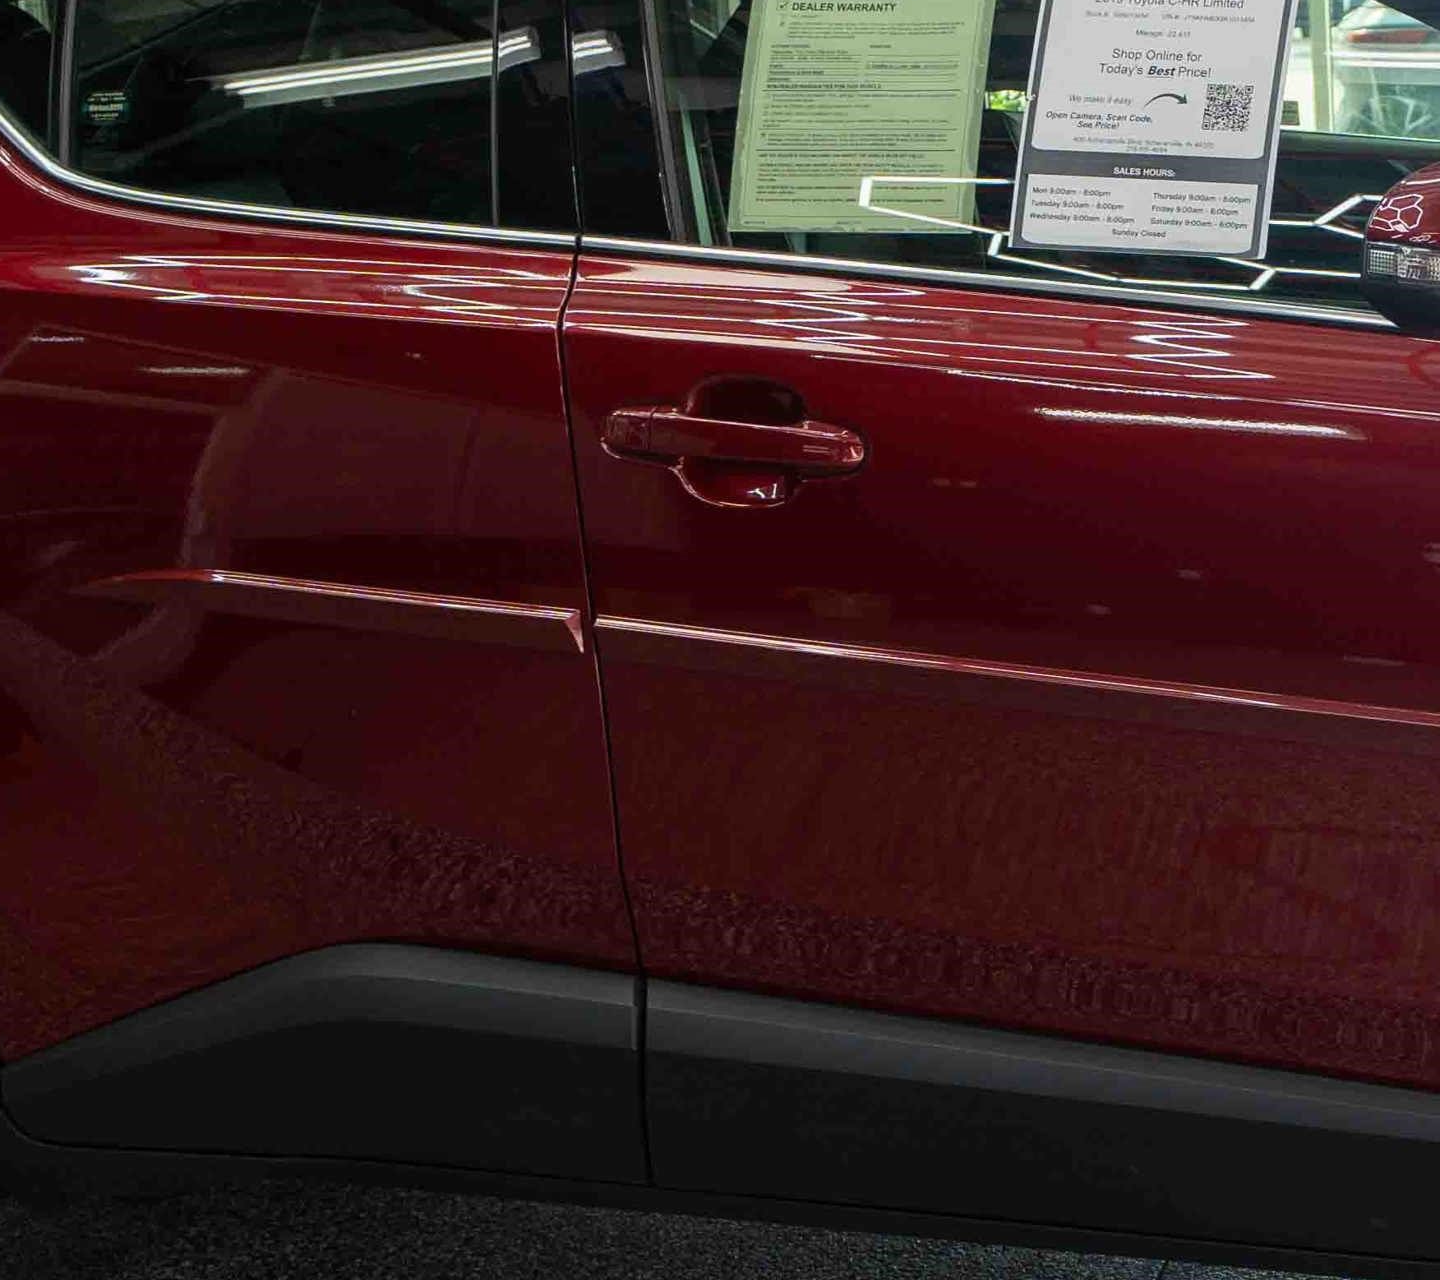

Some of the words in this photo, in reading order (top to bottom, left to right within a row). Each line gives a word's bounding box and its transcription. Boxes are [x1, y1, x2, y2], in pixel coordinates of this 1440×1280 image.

[792, 2, 834, 12] DEALER
[836, 2, 897, 13] WARRANTY
[1111, 47, 1142, 62] Shop
[1145, 49, 1184, 62] Online
[1186, 51, 1203, 63] for
[1099, 62, 1144, 77] Today's
[1146, 64, 1176, 78] Best
[1177, 66, 1212, 78] Price!
[1046, 110, 1068, 120] Open
[1105, 112, 1128, 122] Scan
[1077, 120, 1093, 129] See
[1113, 166, 1141, 177] SALES
[1143, 167, 1176, 178] HOURS:
[1152, 192, 1187, 201] Thursday
[1032, 200, 1061, 209] Tuesday
[1029, 212, 1071, 222] Wednesday
[1150, 217, 1183, 227] Saturday
[1112, 228, 1139, 238] Sunday
[1140, 229, 1167, 239] Closed
